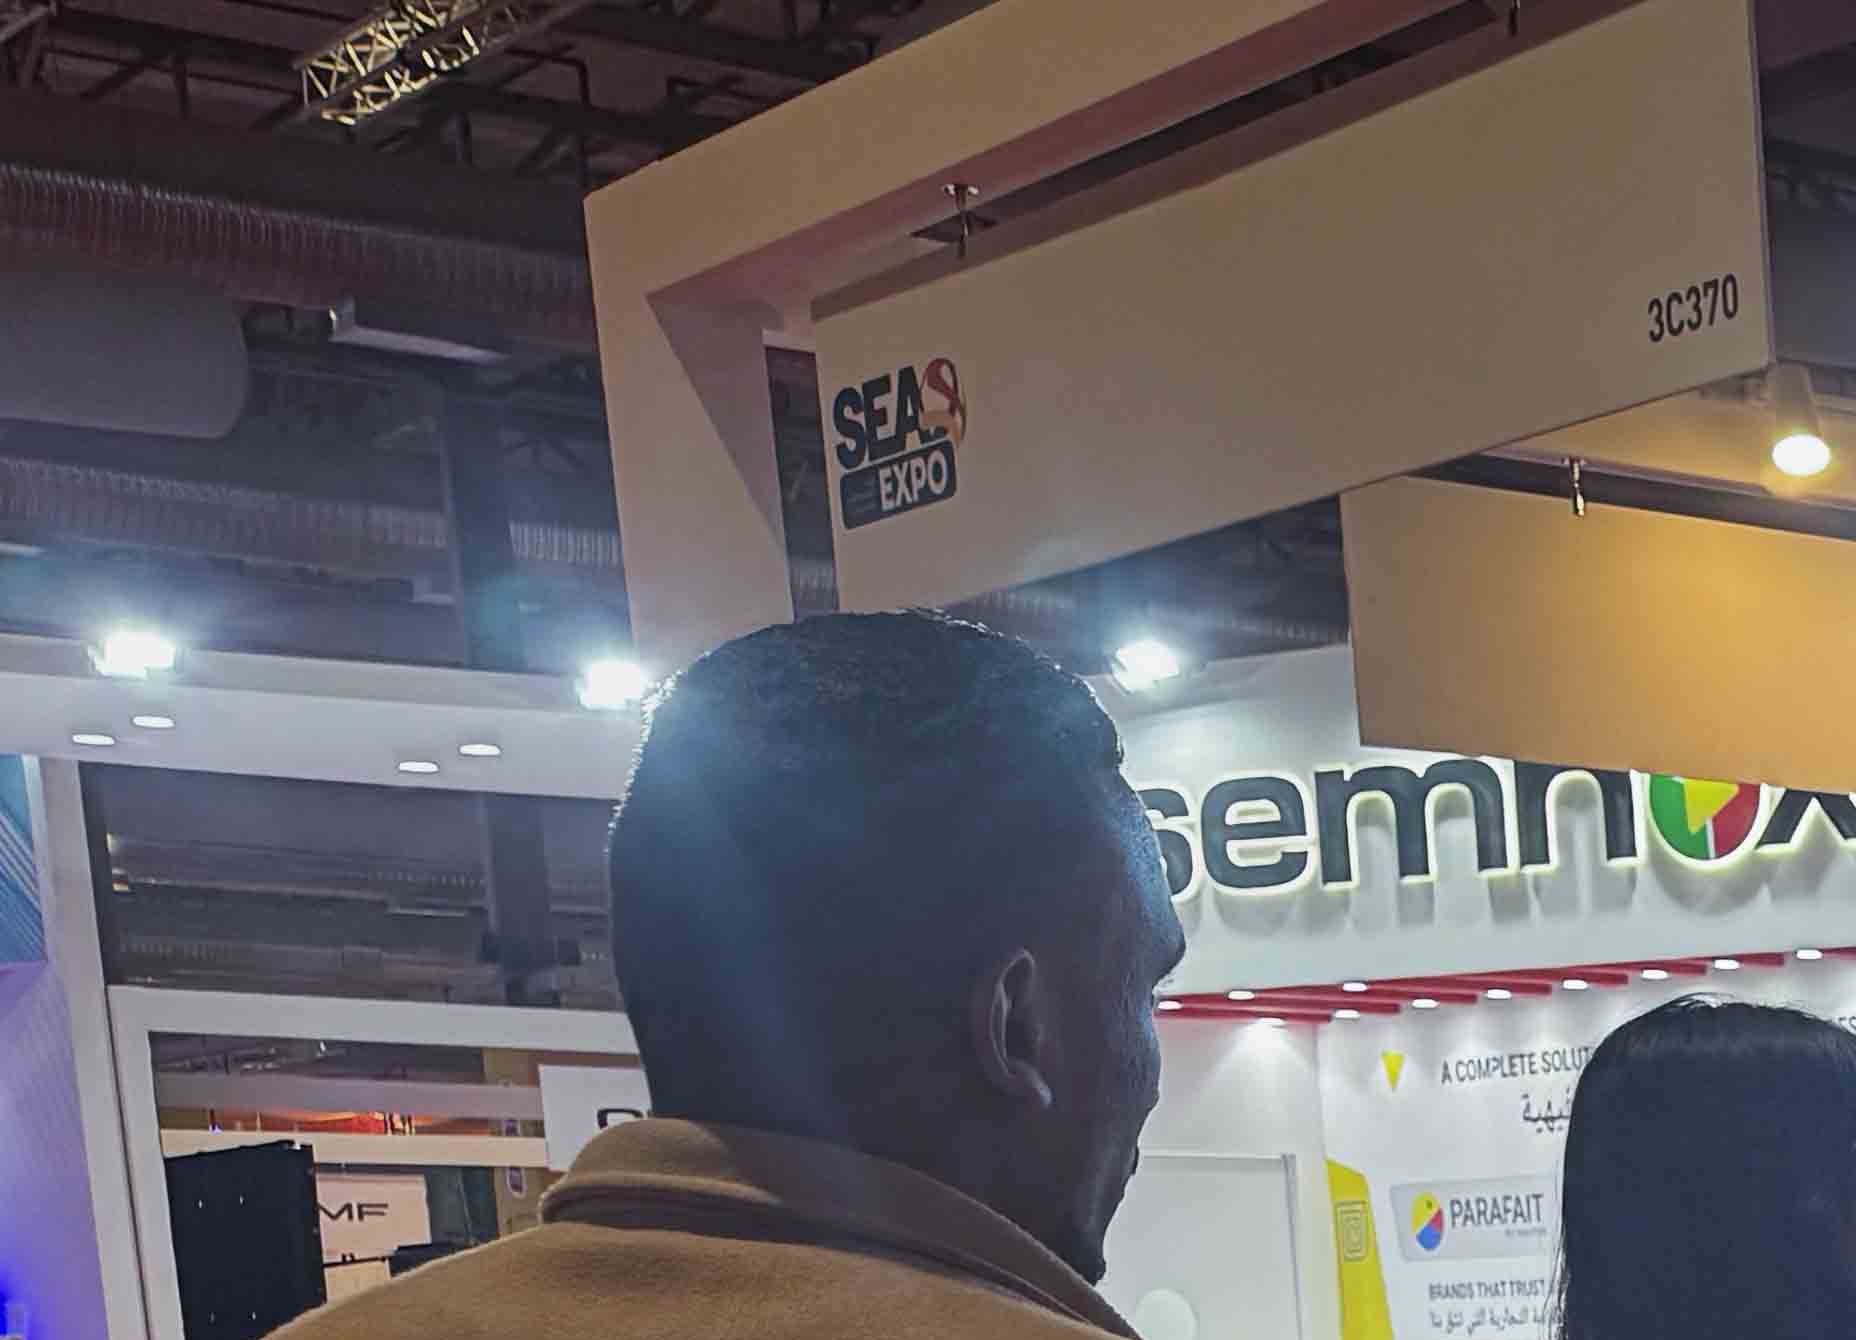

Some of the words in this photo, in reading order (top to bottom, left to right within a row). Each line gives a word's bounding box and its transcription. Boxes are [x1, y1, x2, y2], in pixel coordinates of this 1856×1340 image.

[1647, 273, 1739, 344] 3C370
[878, 449, 949, 511] EXPO
[1441, 1059, 1453, 1086] A
[1455, 1052, 1537, 1083] COMPLETE
[1450, 1193, 1544, 1229] PARAFAIT
[1429, 1282, 1475, 1300] BRANDS
[1477, 1280, 1507, 1297] THAT
